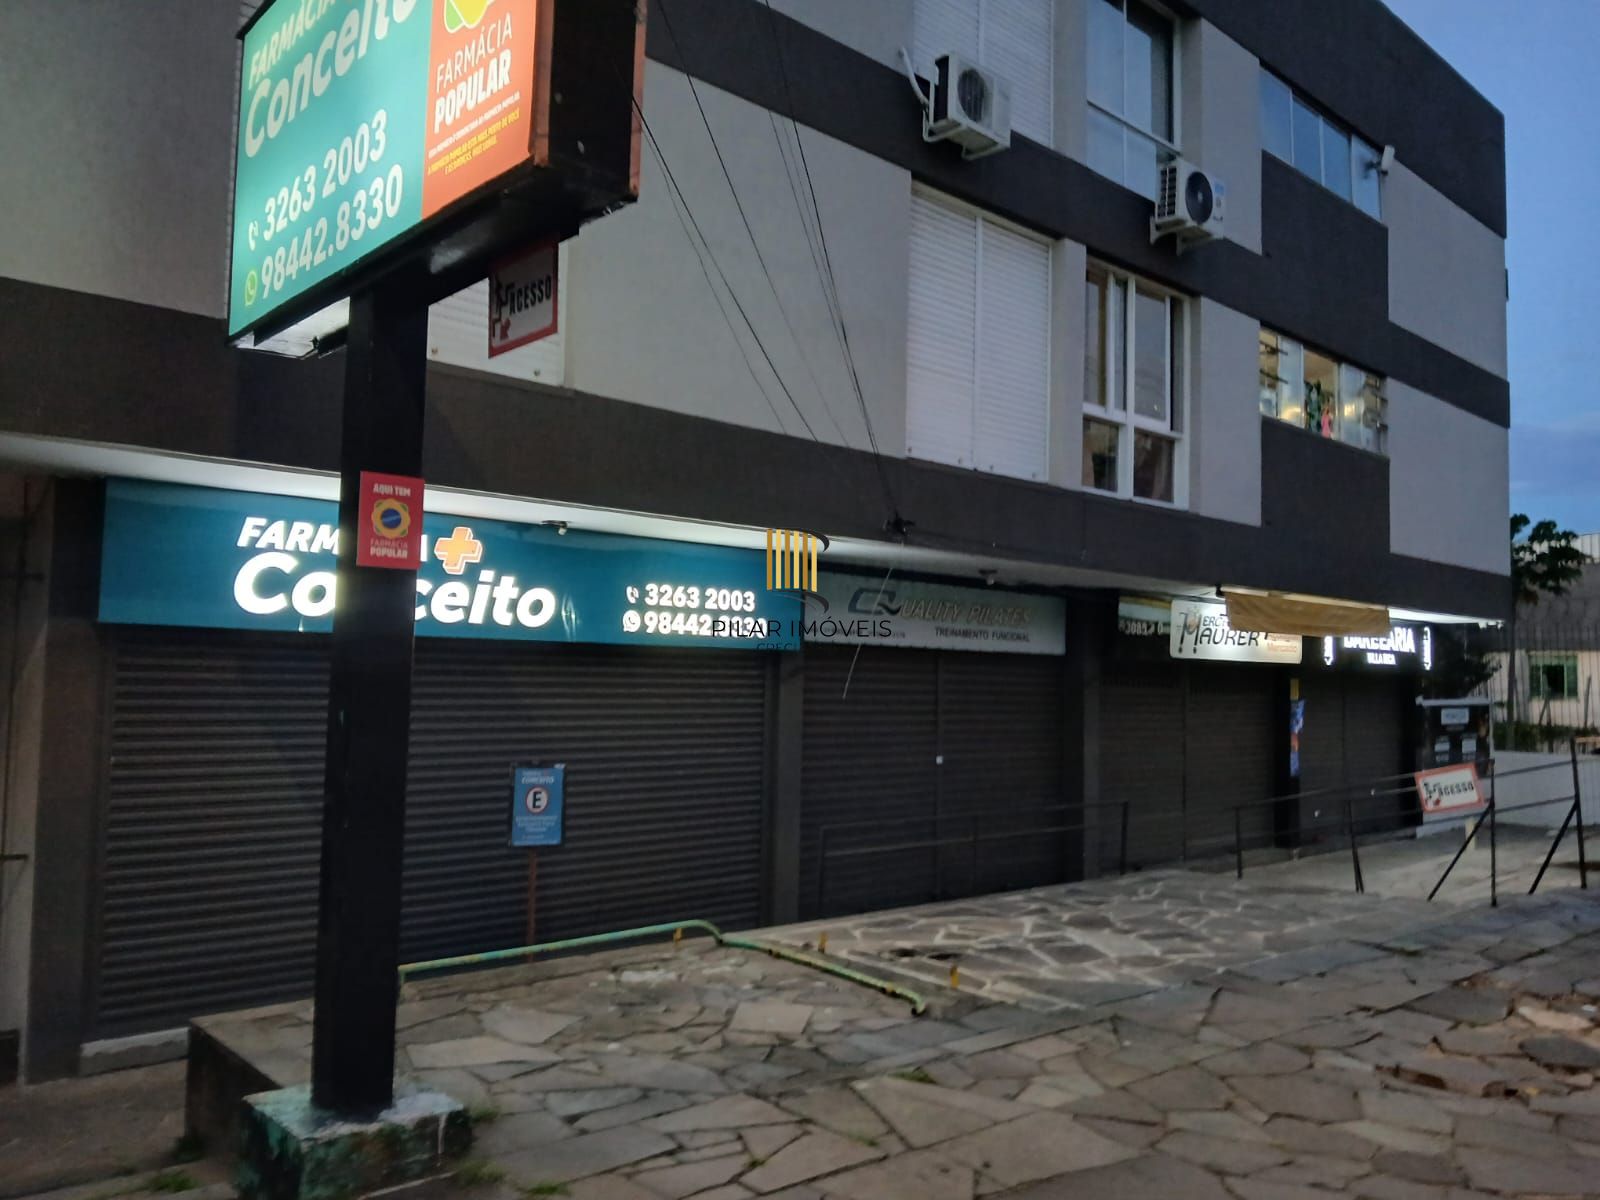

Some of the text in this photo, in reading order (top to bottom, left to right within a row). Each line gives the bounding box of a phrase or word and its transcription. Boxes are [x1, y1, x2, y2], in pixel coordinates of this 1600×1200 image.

[436, 12, 513, 94] FARMÁCIA
[433, 49, 511, 135] POPULAR
[263, 165, 316, 241] 3263
[322, 109, 387, 198] 2003
[261, 164, 403, 299] 98442.8330
[510, 274, 552, 317] ACESSO
[373, 483, 411, 497] AQUI TEM
[370, 547, 408, 560] POPULAR
[233, 552, 556, 628] Coceito
[644, 583, 755, 612] 3263 2003
[967, 603, 1033, 626] PILATES
[935, 626, 1031, 643] TREINAMENTO FUNCIONAL
[532, 790, 542, 809] E
